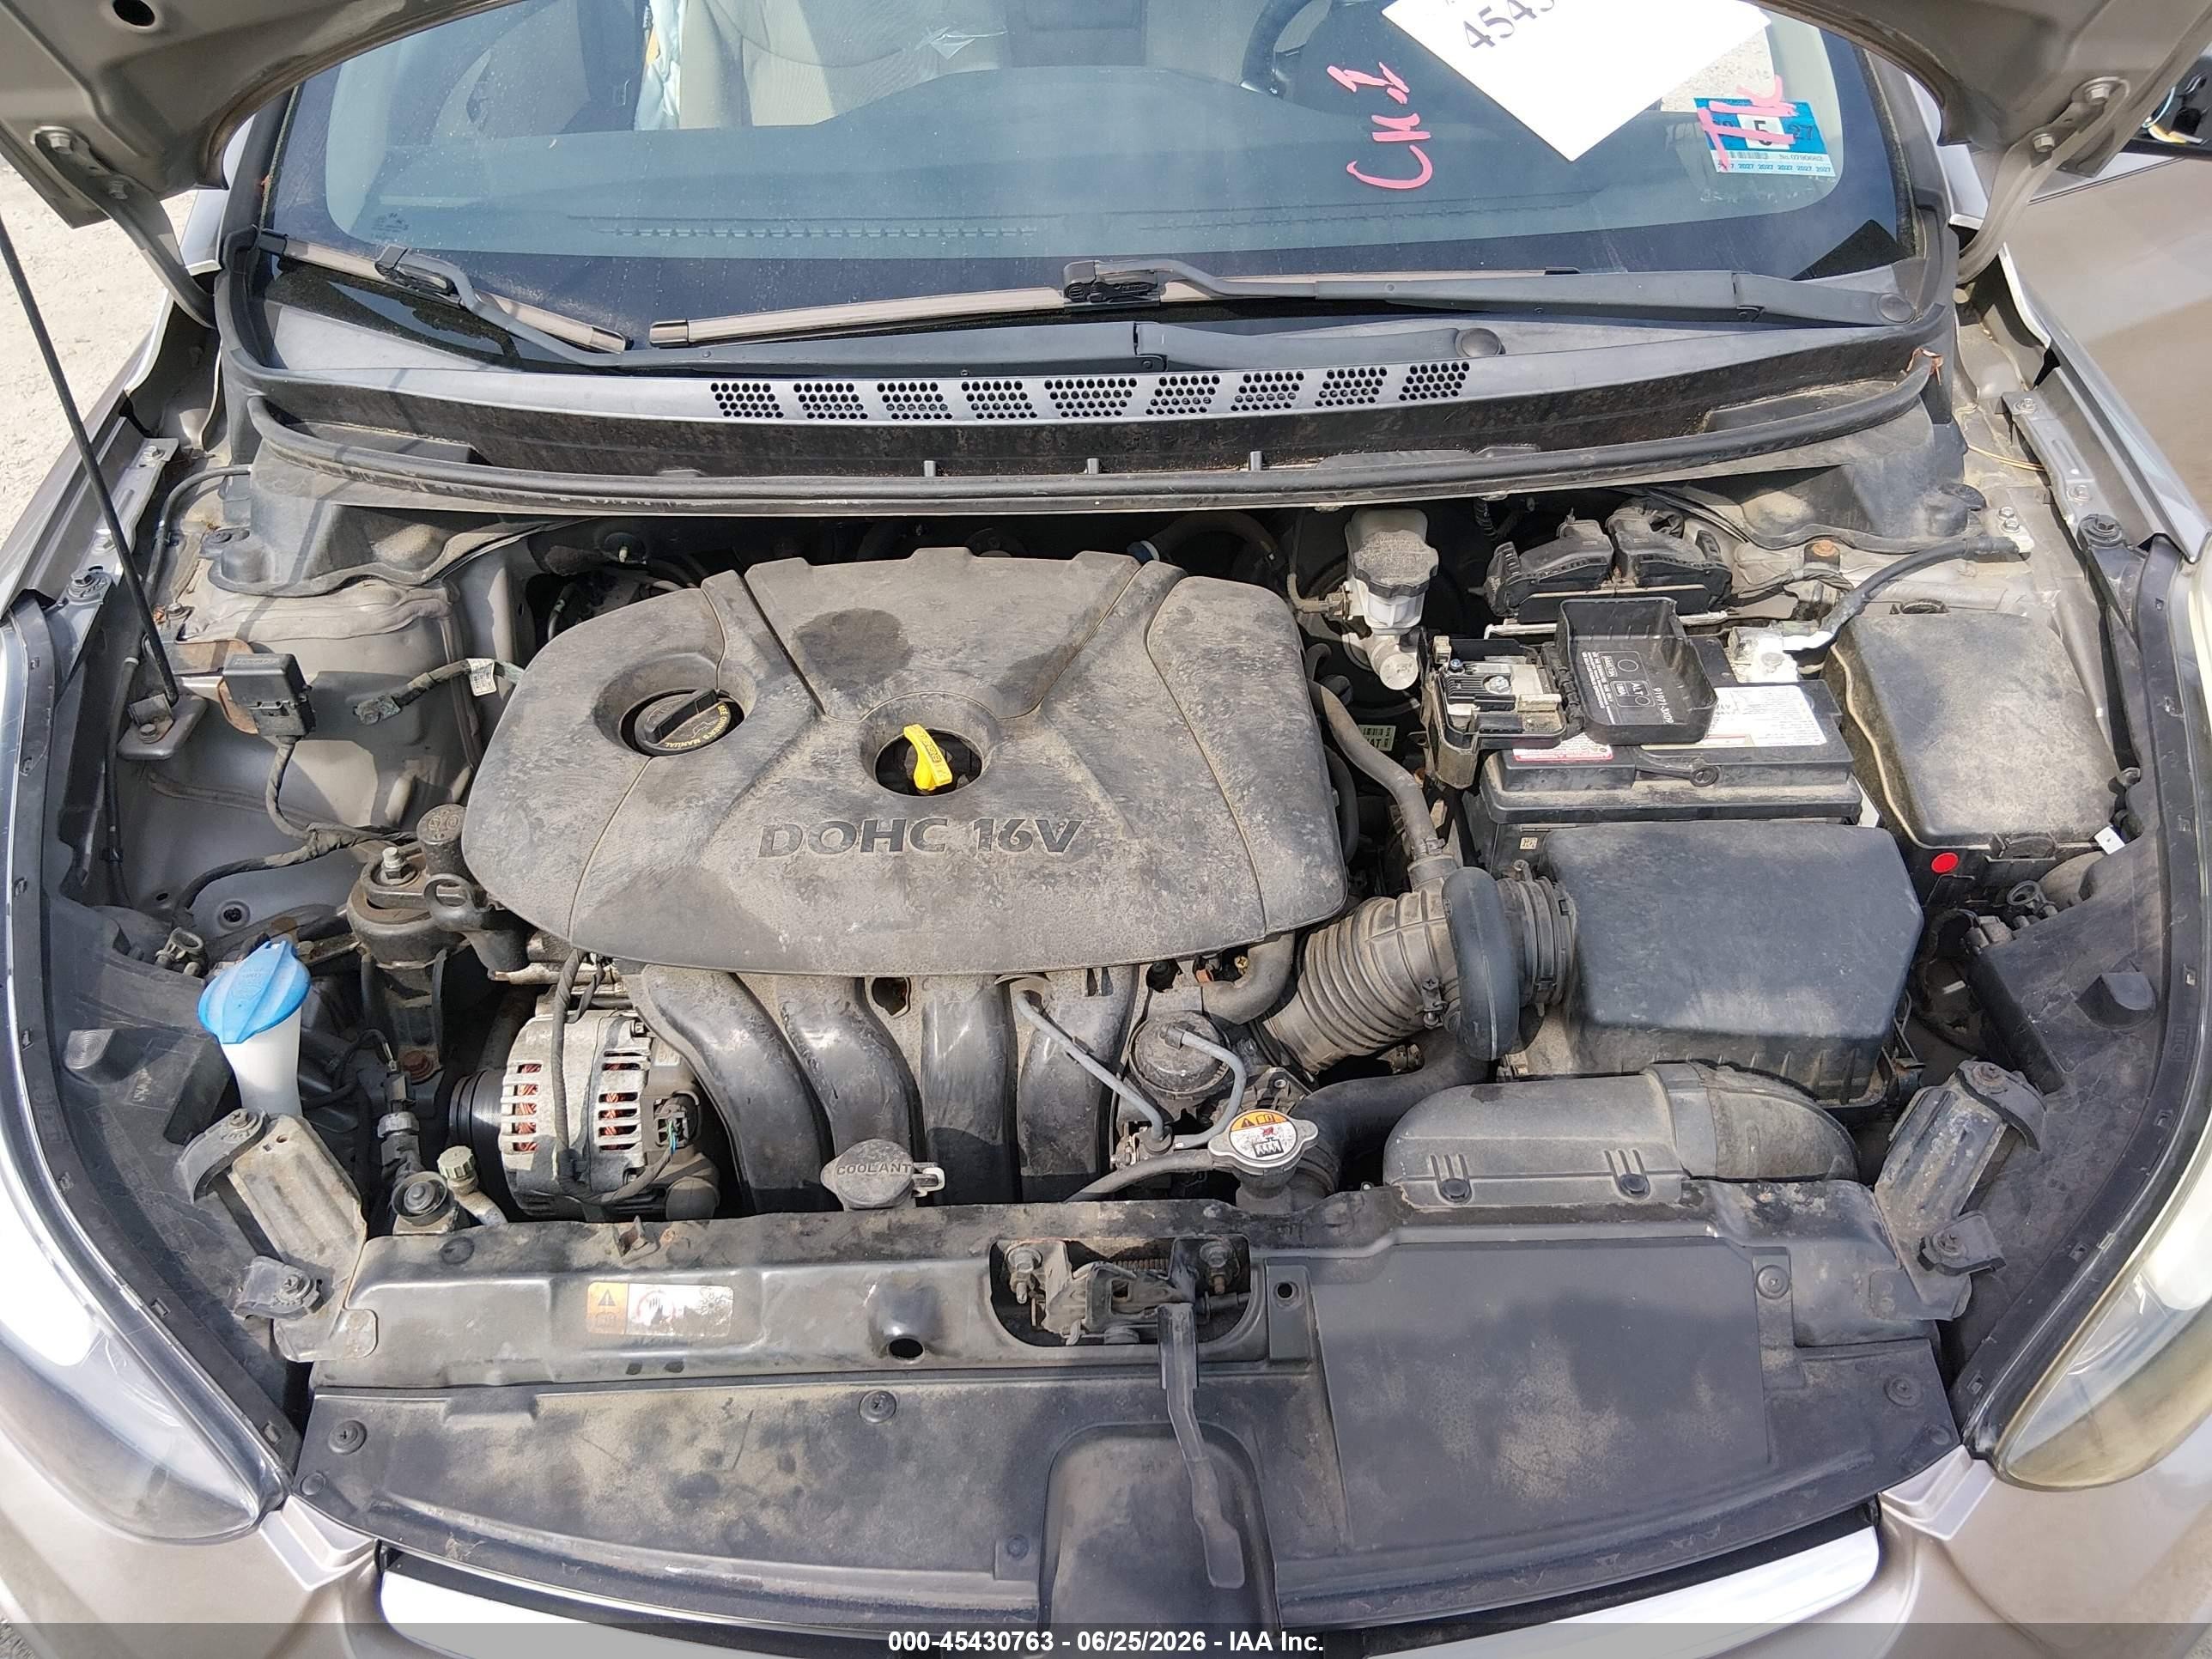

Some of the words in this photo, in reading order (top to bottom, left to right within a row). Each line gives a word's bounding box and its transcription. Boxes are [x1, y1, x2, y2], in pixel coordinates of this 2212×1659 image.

[1753, 119, 1773, 147] 5
[1631, 682, 1644, 696] ALT
[717, 705, 729, 715] SEE
[665, 738, 702, 748] MANUAL
[758, 817, 949, 858] DOHC
[973, 817, 1083, 854] 16V
[836, 1163, 912, 1176] COOLANT
